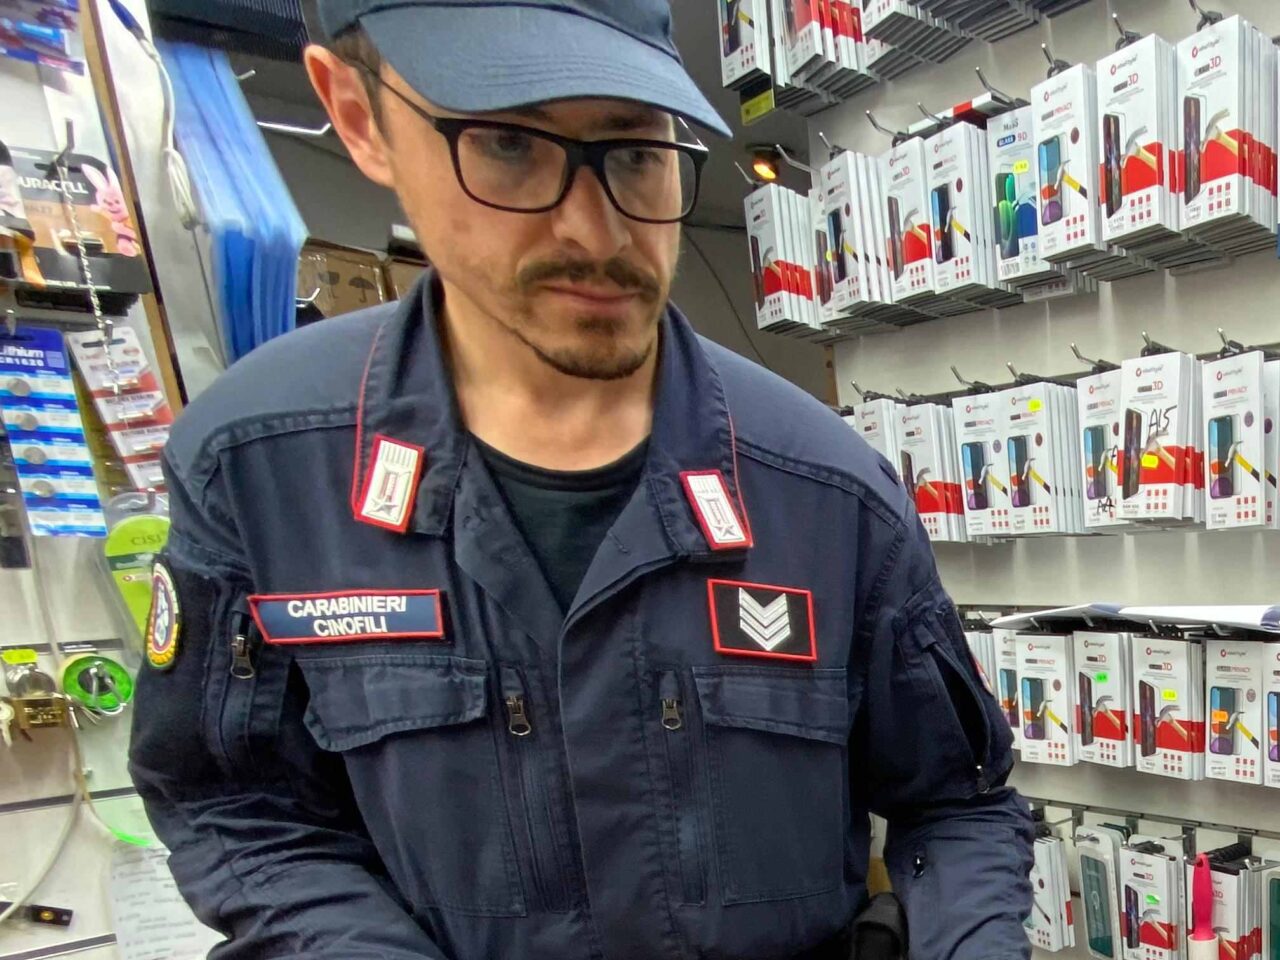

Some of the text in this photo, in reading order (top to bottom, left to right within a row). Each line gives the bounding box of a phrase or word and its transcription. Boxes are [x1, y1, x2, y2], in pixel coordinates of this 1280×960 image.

[1209, 55, 1222, 70] 3D
[1127, 73, 1139, 86] 3D
[1152, 381, 1163, 390] 3D
[1149, 405, 1177, 436] A15
[287, 596, 407, 618] CARABINIERI
[313, 616, 388, 637] CINOFILI
